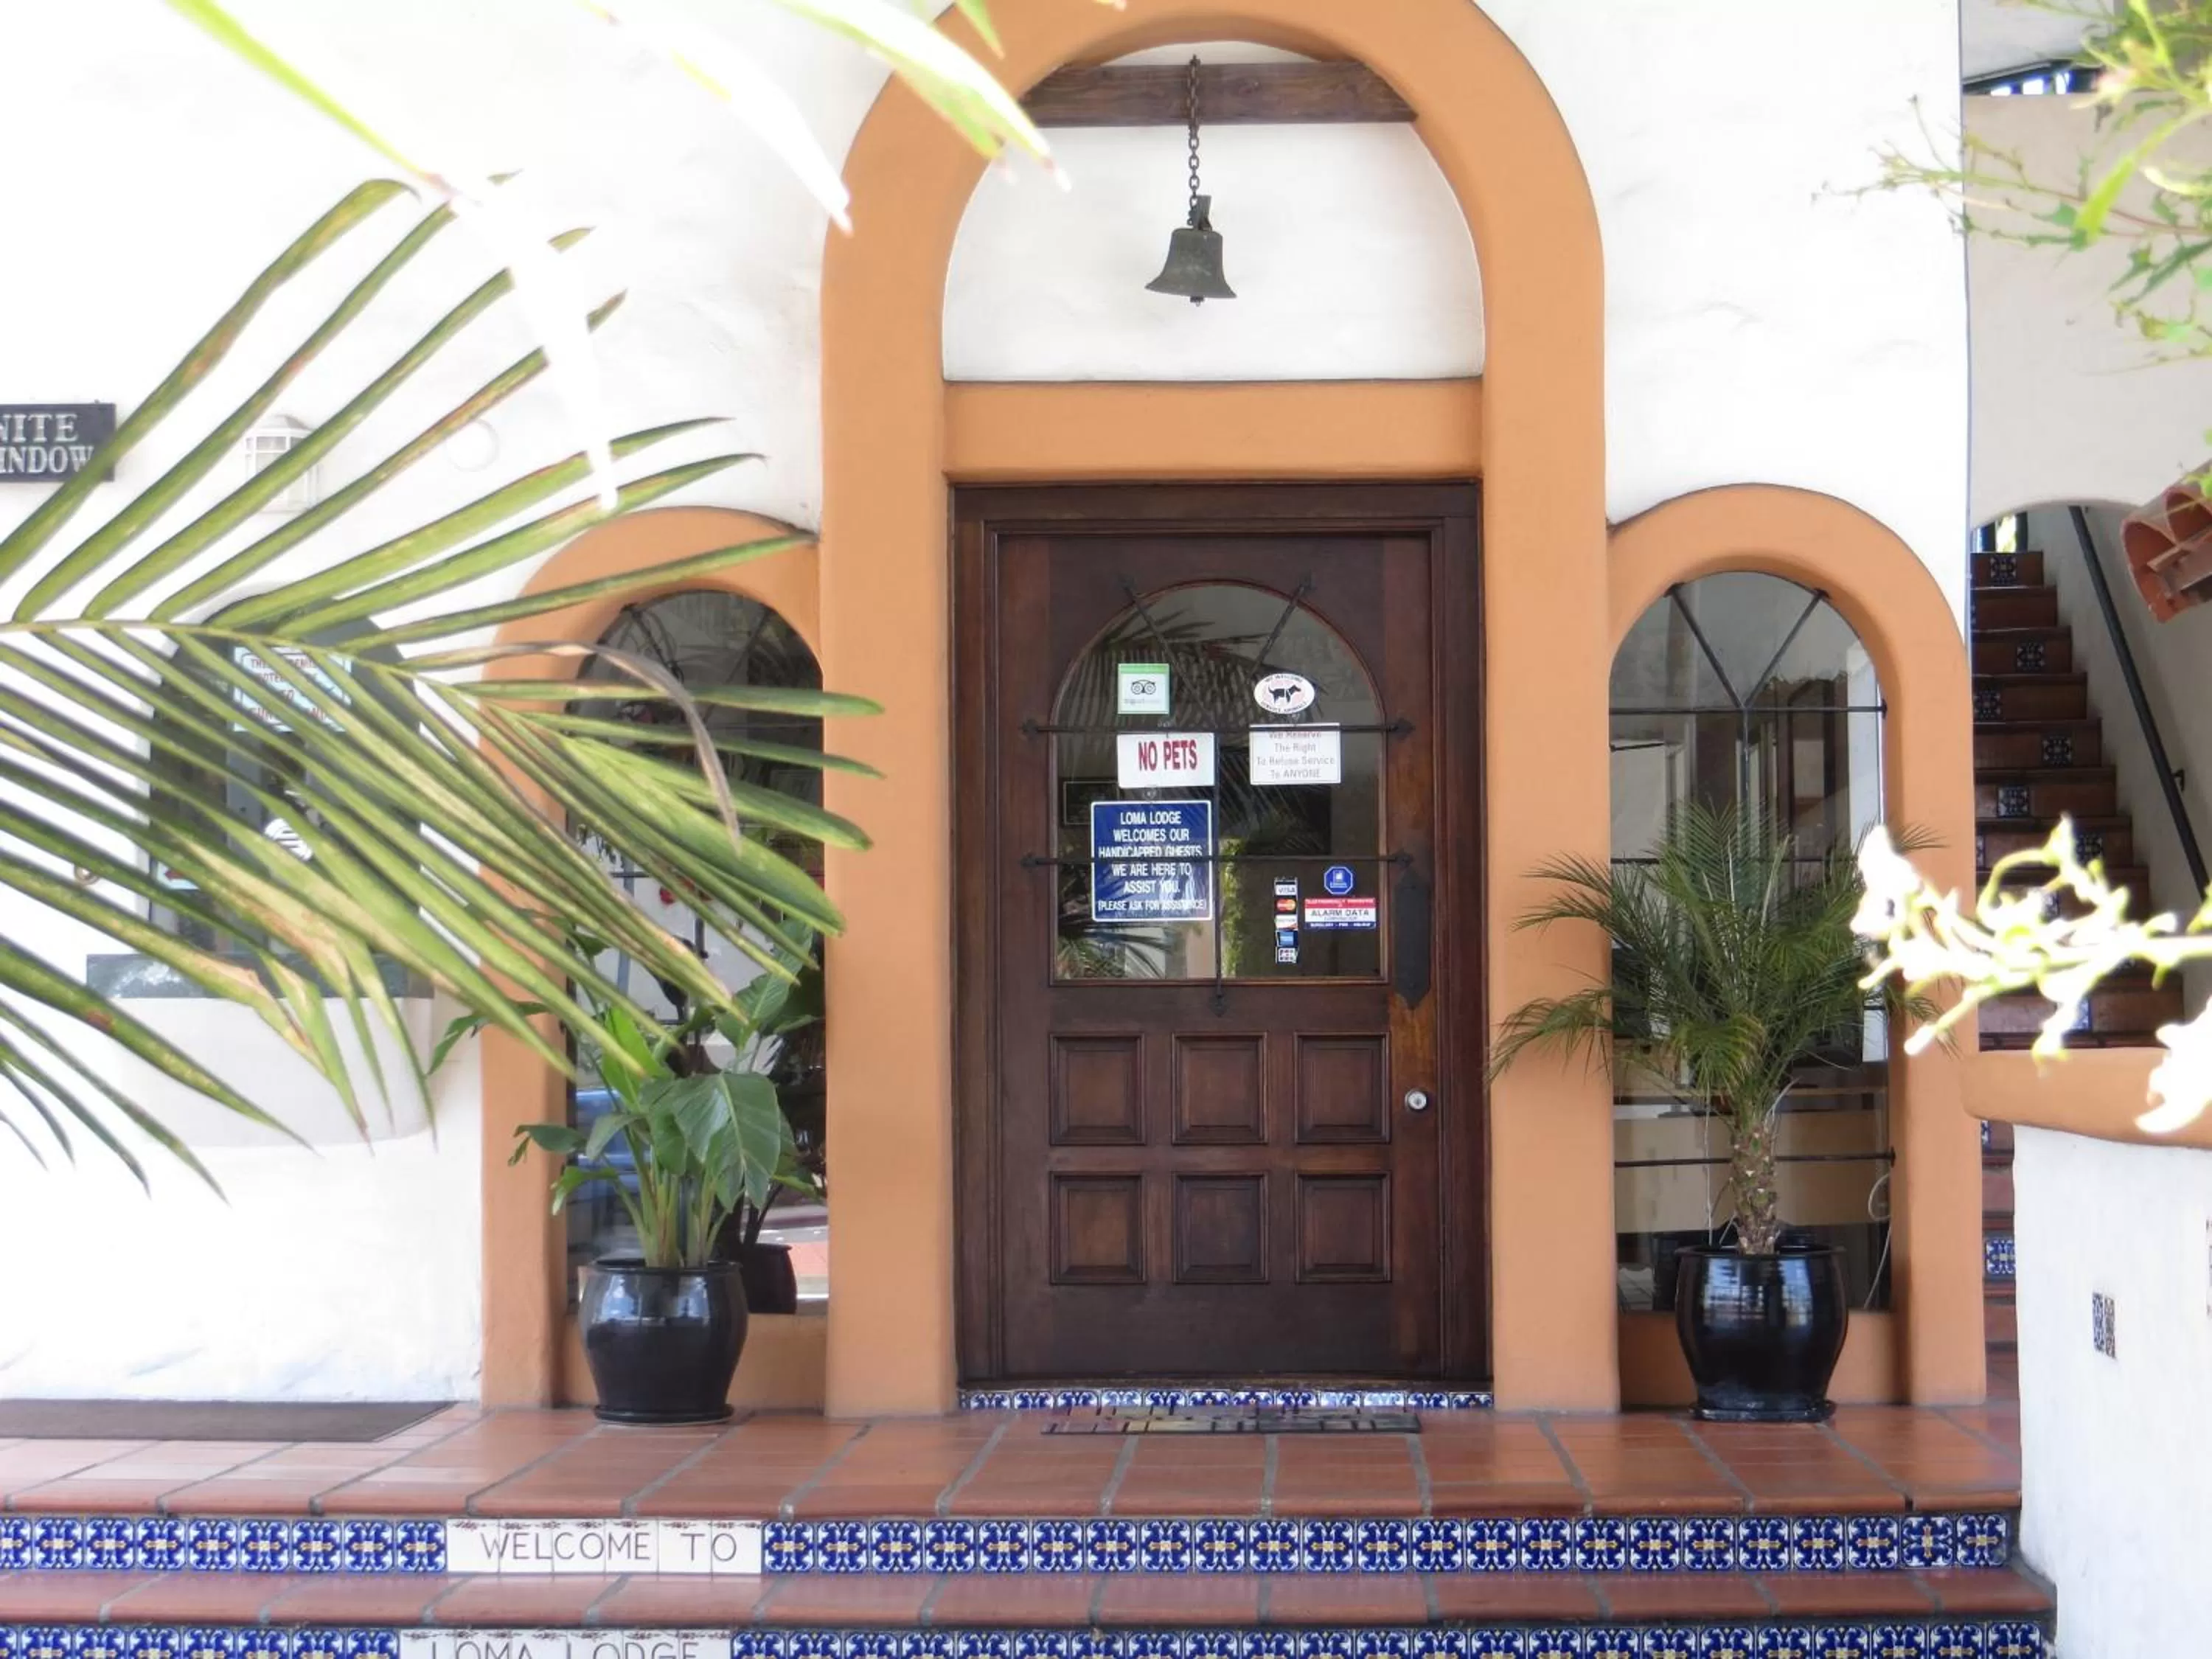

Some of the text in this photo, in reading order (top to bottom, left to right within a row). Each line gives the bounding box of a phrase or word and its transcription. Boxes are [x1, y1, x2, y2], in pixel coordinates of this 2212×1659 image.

[1274, 742, 1316, 754] The Right
[1138, 740, 1197, 771] NO PETS
[1257, 756, 1266, 765] To
[1301, 756, 1335, 765] Service
[1269, 769, 1321, 779] To ANYONE
[1120, 811, 1182, 825] LOMA LODGE
[1113, 828, 1189, 842] WELCOMES OUR
[1098, 845, 1203, 858] HANDICAPPED GUESTS
[1111, 863, 1192, 876] WE ARE HERE TO
[1123, 880, 1156, 894] ASSIST
[1098, 900, 1127, 911] (PLEASE
[1129, 900, 1143, 911] ASK
[1145, 900, 1159, 911] FOR
[481, 1531, 737, 1562] WELCOME TO
